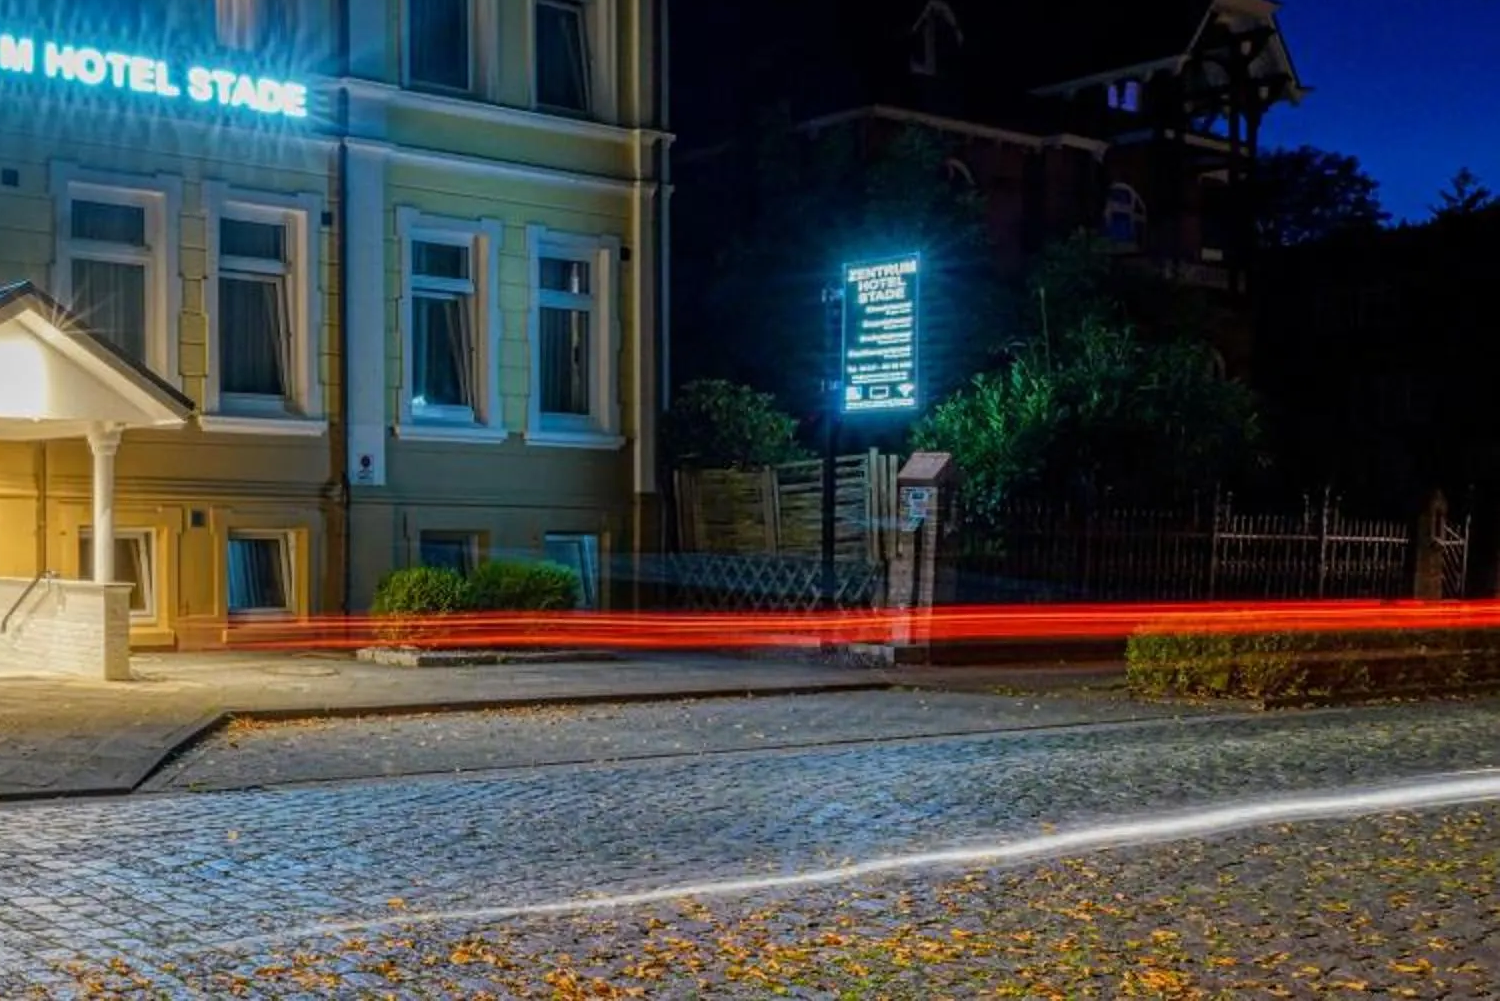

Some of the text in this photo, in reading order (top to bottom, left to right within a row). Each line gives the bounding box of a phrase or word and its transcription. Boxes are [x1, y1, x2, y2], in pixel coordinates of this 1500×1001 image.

[45, 43, 179, 96] HOTEL
[188, 66, 307, 117] STADE
[858, 276, 907, 292] HOTEL
[858, 288, 906, 304] STADE
